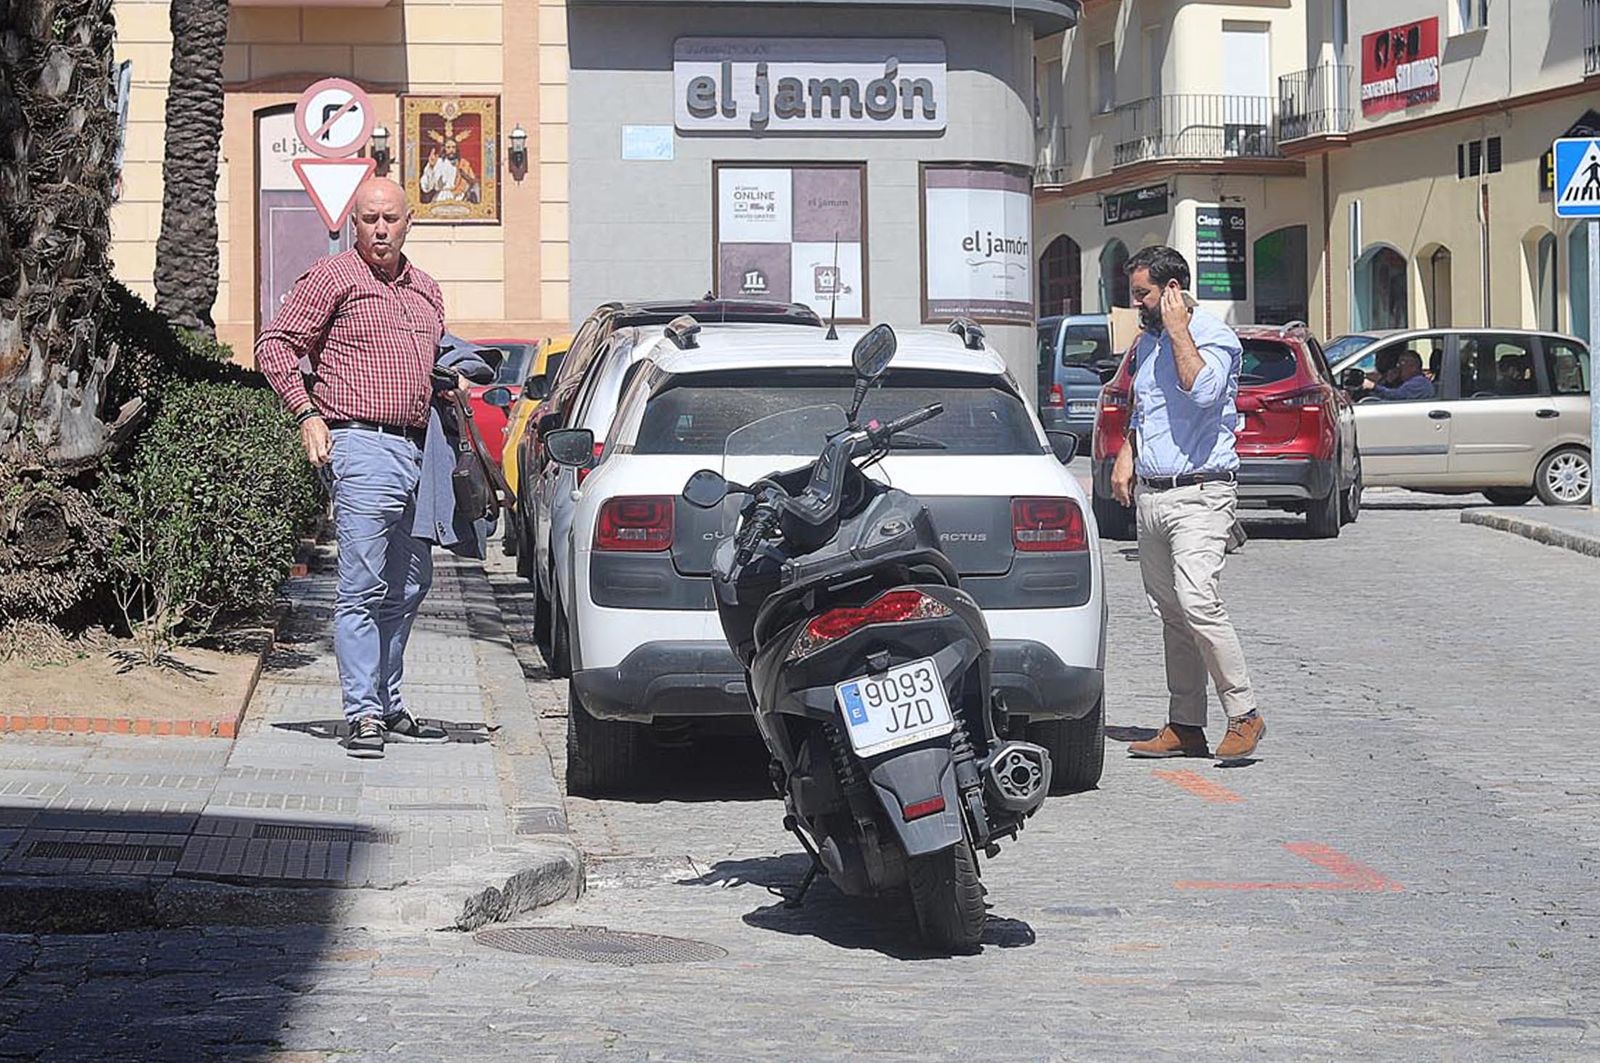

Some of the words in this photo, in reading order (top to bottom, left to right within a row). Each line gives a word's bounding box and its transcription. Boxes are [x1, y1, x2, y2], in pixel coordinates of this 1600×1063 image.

[687, 60, 737, 119] el
[751, 56, 937, 129] jamón
[272, 137, 287, 153] el
[733, 191, 775, 200] ONLINE
[962, 230, 981, 252] el
[940, 533, 987, 542] ACTUS
[865, 668, 934, 708] 9093
[852, 708, 861, 718] E
[886, 698, 934, 733] JZD
